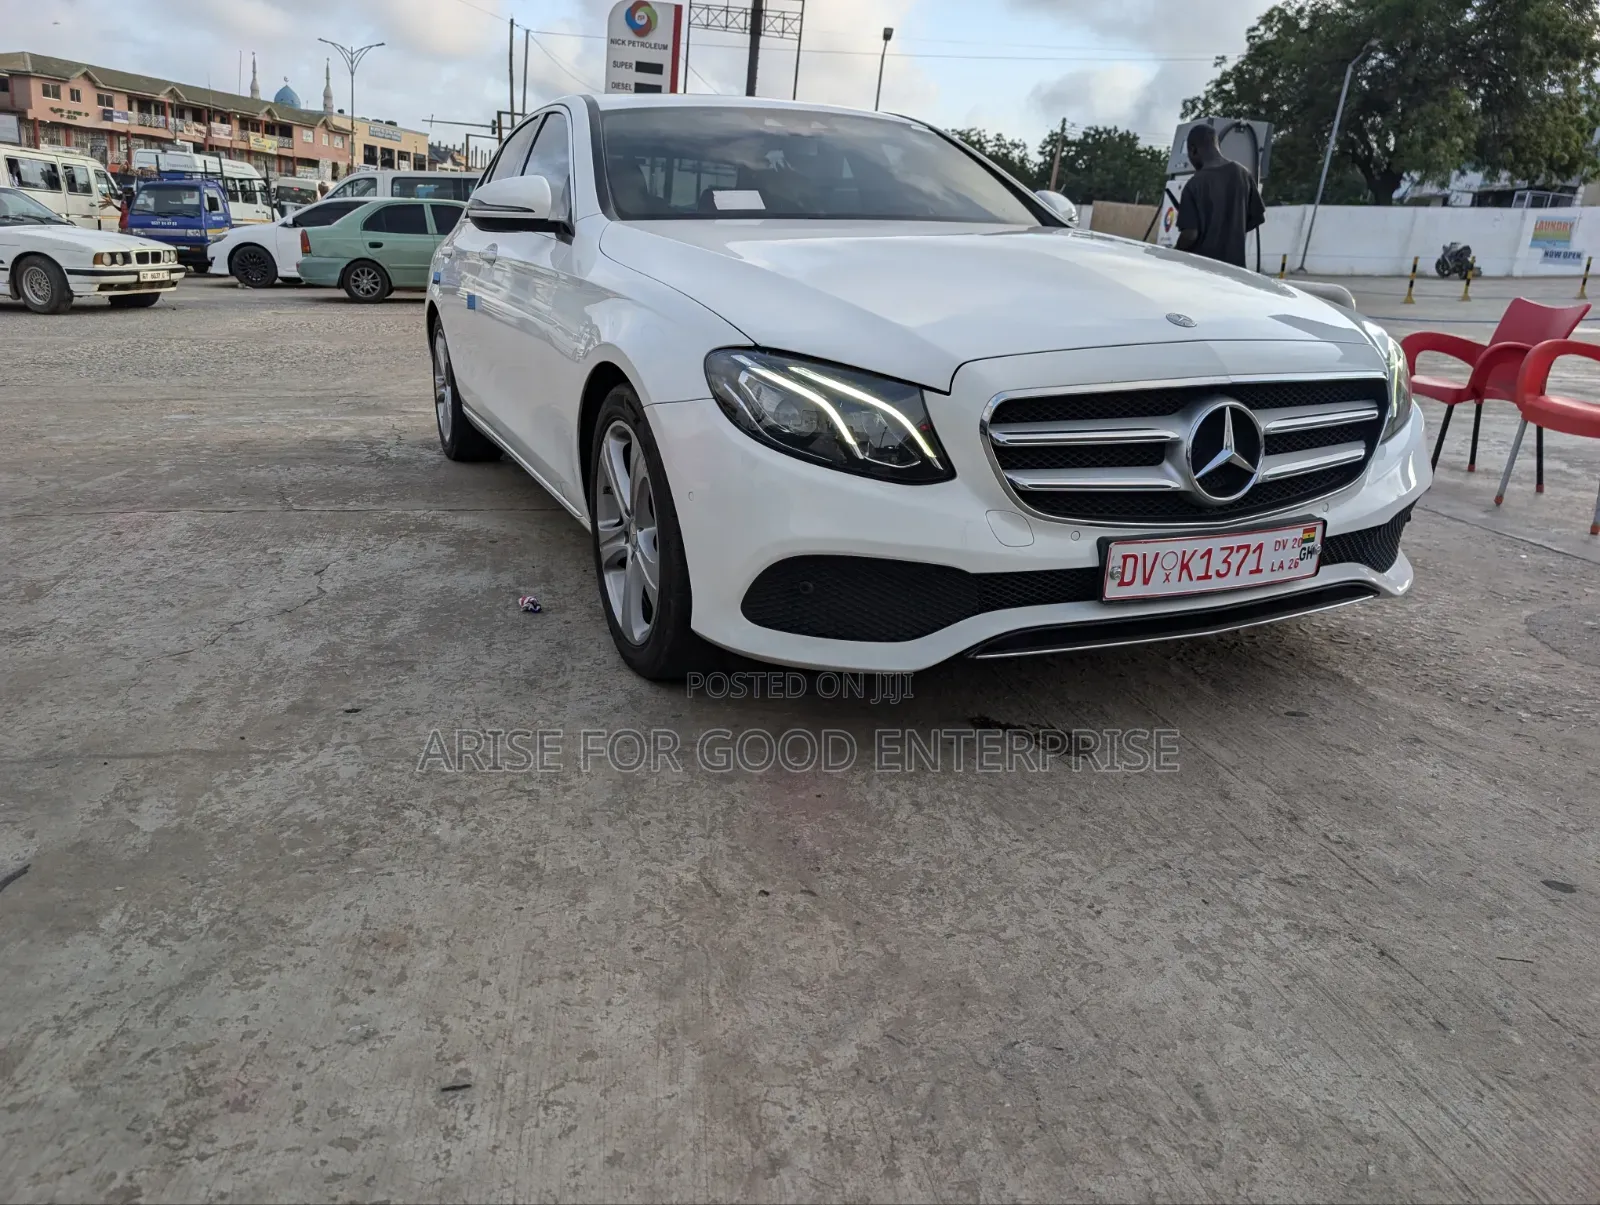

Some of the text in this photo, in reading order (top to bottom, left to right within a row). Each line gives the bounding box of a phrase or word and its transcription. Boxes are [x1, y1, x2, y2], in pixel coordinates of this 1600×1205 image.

[610, 38, 668, 50] NICK PETROLEUM
[612, 60, 633, 69] SUPER
[611, 81, 632, 91] DIESEL
[1535, 220, 1574, 232] LAUNDRY
[1543, 250, 1582, 260] NOW OPEN
[1273, 537, 1304, 551] DV 20
[1299, 545, 1315, 561] GH
[1117, 552, 1159, 587] DV
[1178, 542, 1264, 583] K1371
[1270, 558, 1300, 572] LA 26
